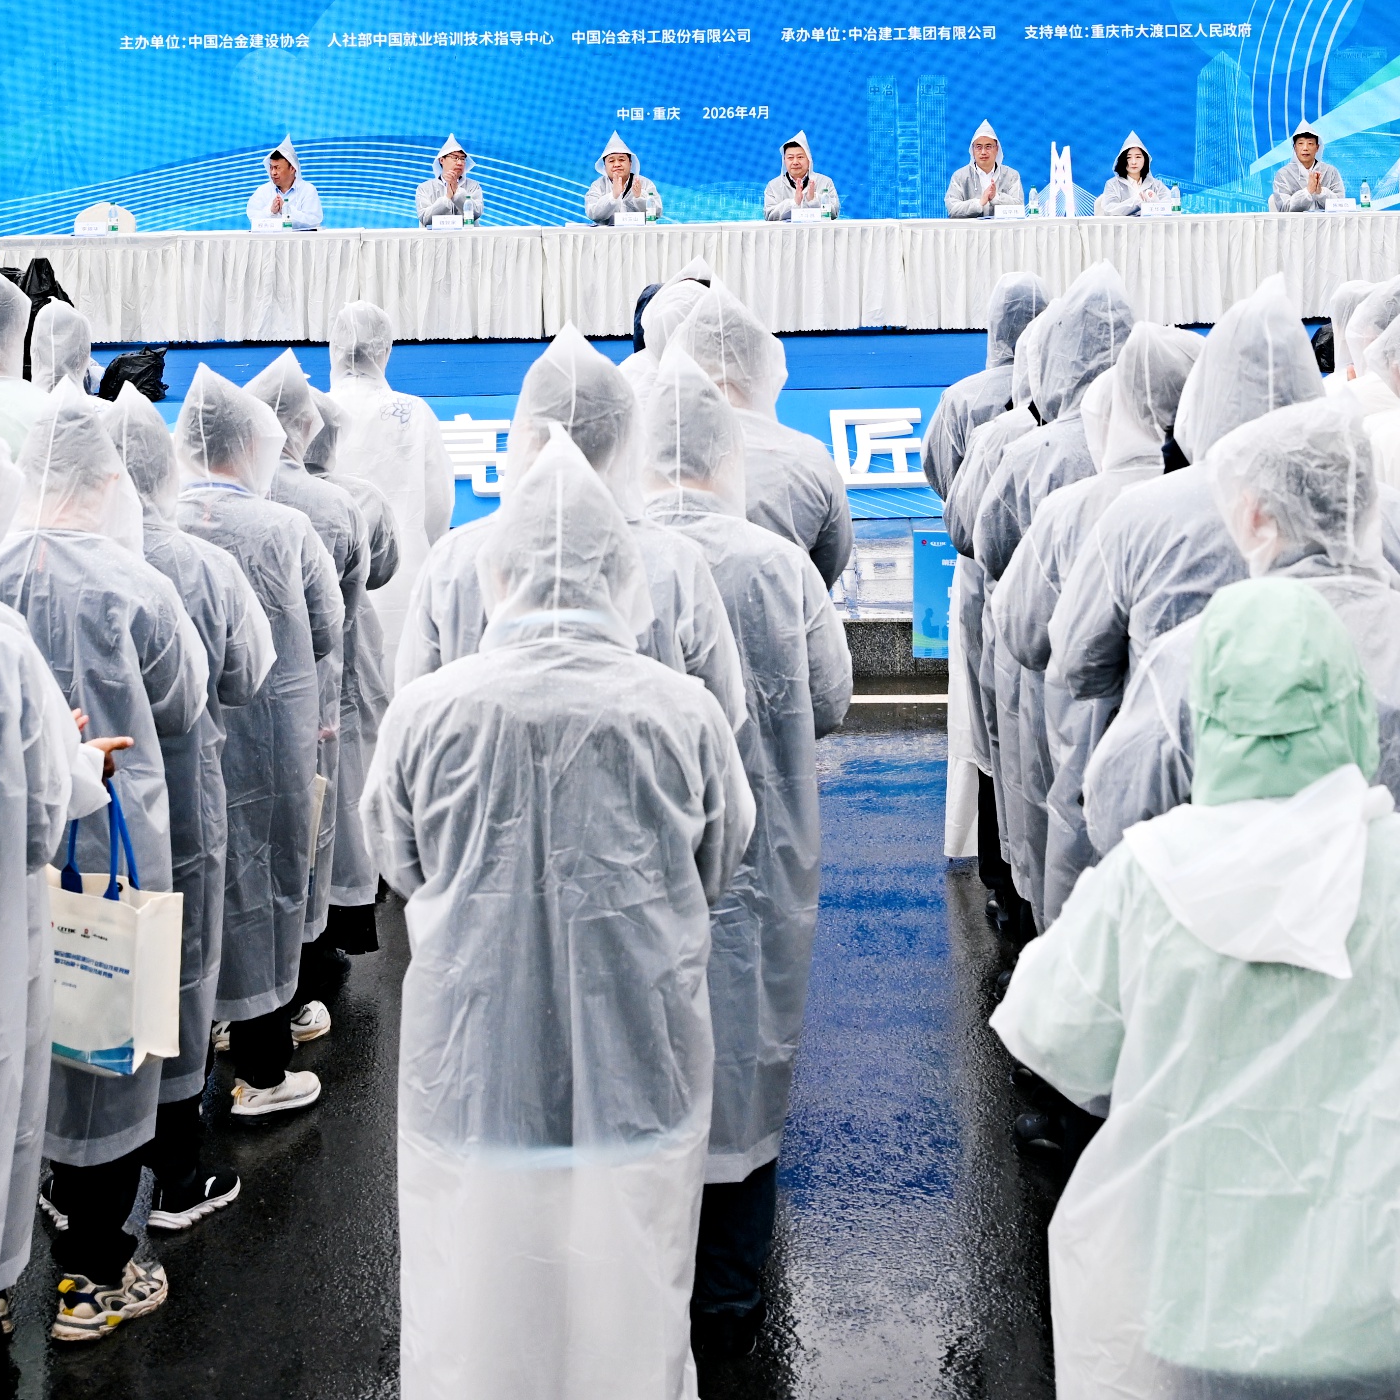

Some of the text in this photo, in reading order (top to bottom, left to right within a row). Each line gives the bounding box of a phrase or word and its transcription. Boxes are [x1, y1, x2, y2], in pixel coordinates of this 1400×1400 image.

[328, 31, 554, 47] 人社部中国就业培训技术指导中心
[572, 29, 751, 45] 中国冶金科工股份有限公司
[703, 106, 769, 119] 2026年4月
[829, 408, 928, 488] 匠
